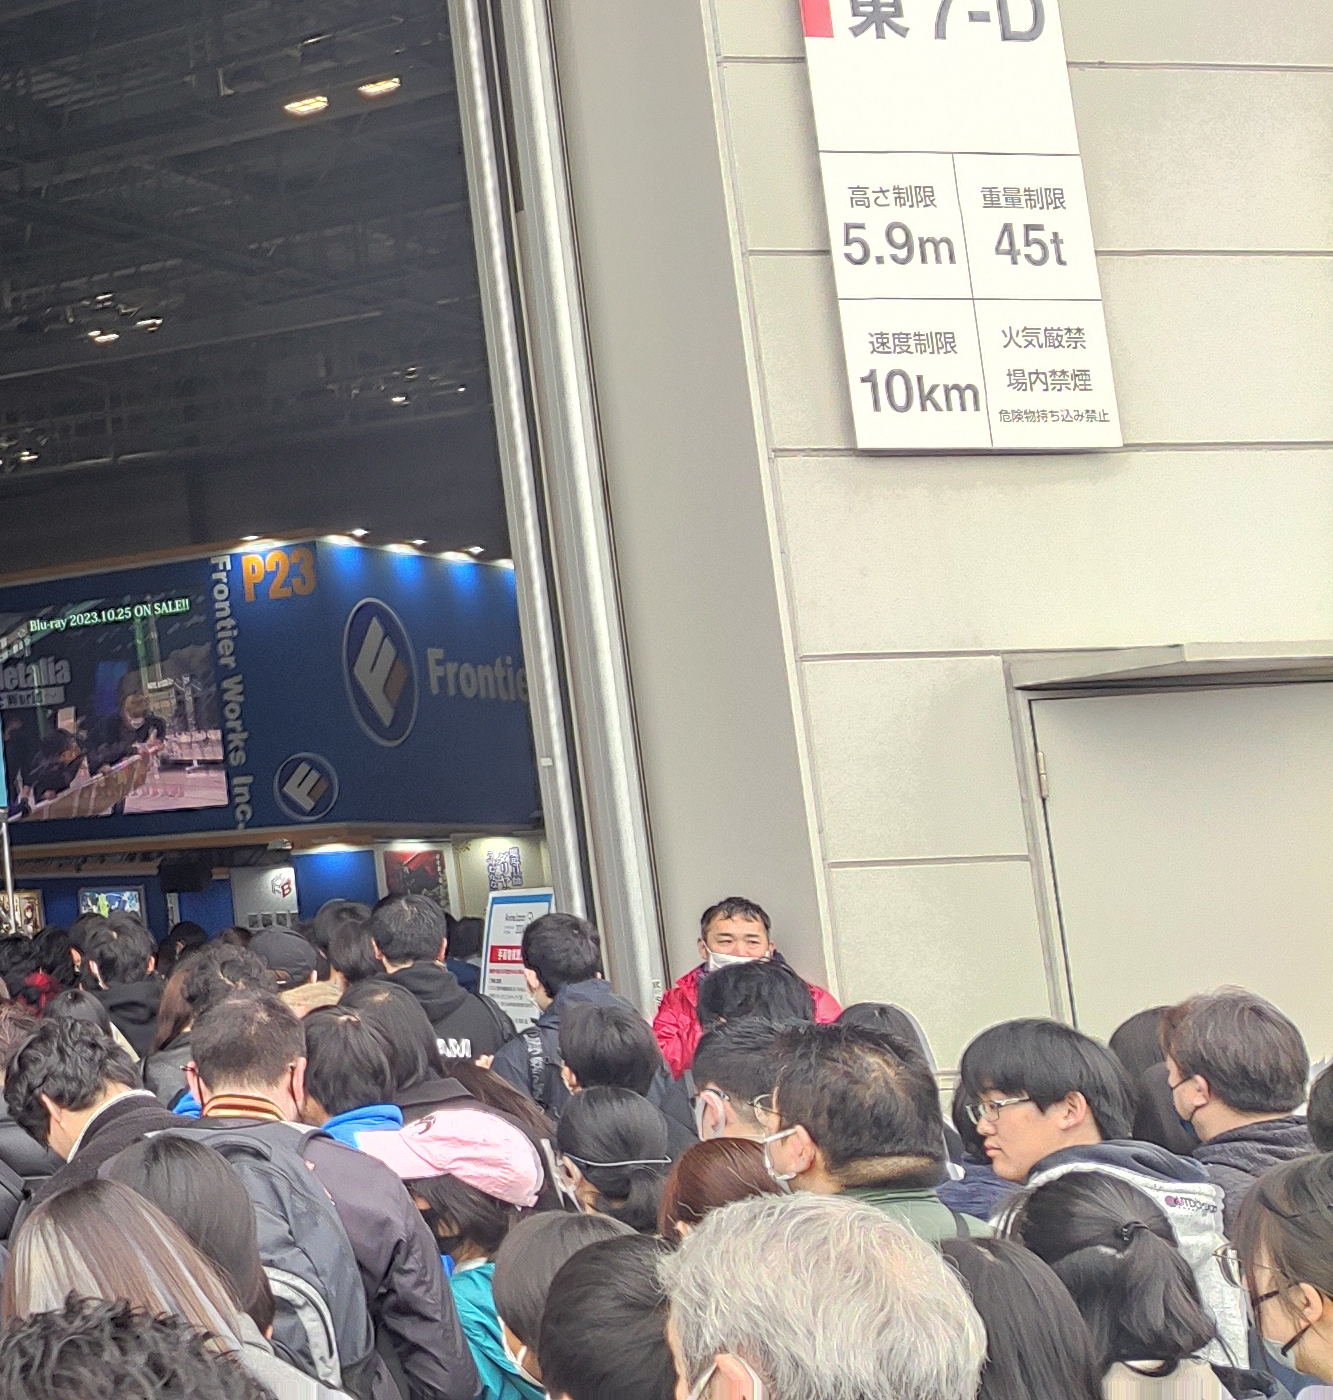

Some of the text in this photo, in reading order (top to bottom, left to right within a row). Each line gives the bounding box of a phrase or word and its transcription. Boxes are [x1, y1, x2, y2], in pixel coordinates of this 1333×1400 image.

[847, 185, 937, 209] 高さ制限
[980, 186, 1067, 210] 重量制限
[843, 221, 956, 265] 5.9m
[994, 222, 1067, 266] 45t
[868, 331, 958, 355] 速度制限
[1001, 326, 1087, 350] 火気厳禁
[860, 368, 981, 413] 10km
[1006, 368, 1094, 392] 場内禁煙
[998, 409, 1111, 423] 危険物持ち込み禁止
[241, 546, 317, 602] P23
[30, 598, 190, 632] Blu-ray 2023.10.25 ON SALE!!
[210, 554, 254, 831] Frontier Works Inc.
